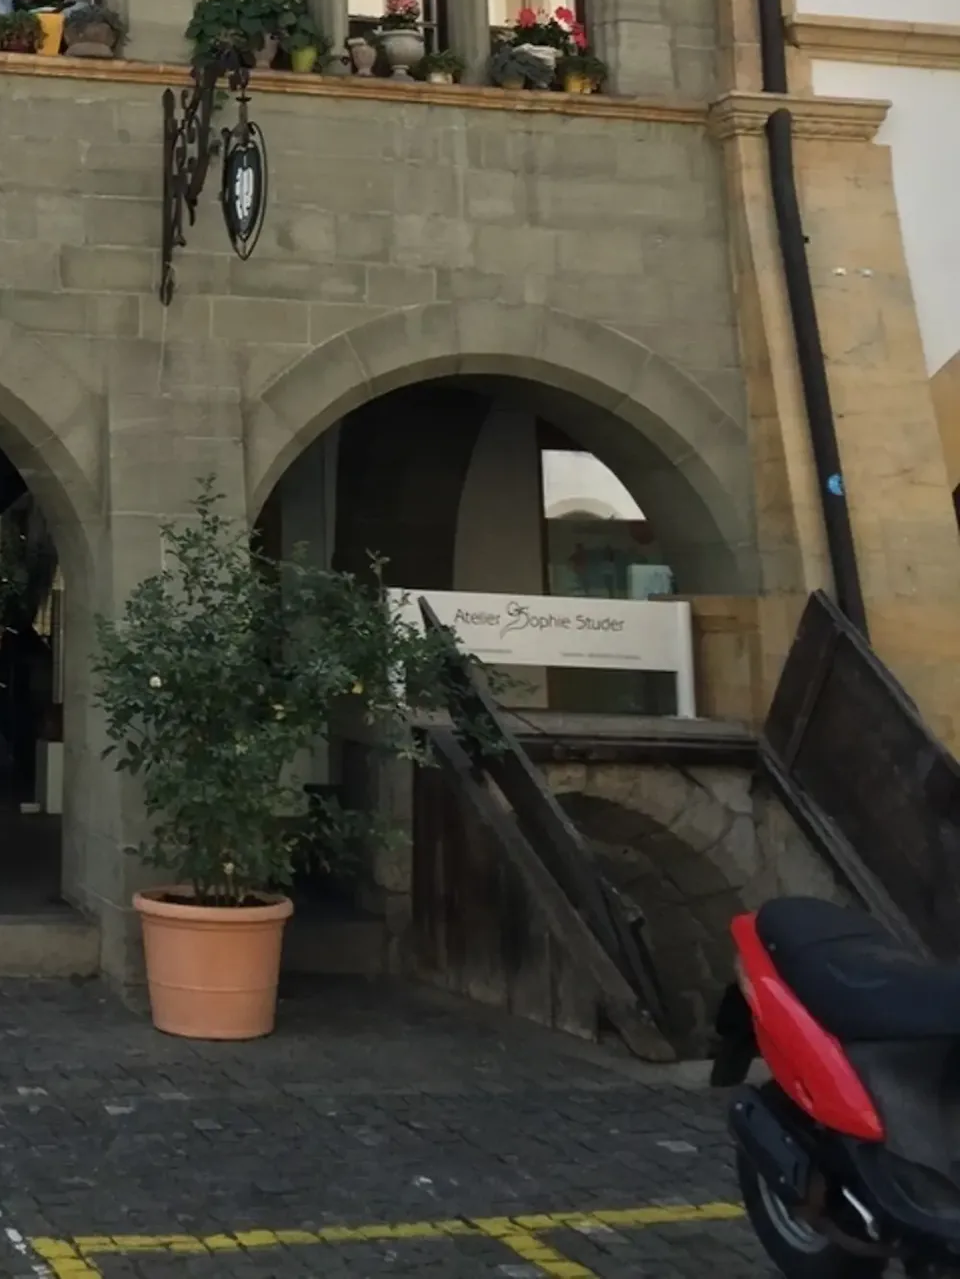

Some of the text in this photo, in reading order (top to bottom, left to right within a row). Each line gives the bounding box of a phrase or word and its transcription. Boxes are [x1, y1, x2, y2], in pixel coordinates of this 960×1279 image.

[454, 601, 625, 640] Atelier Sophie Studer
